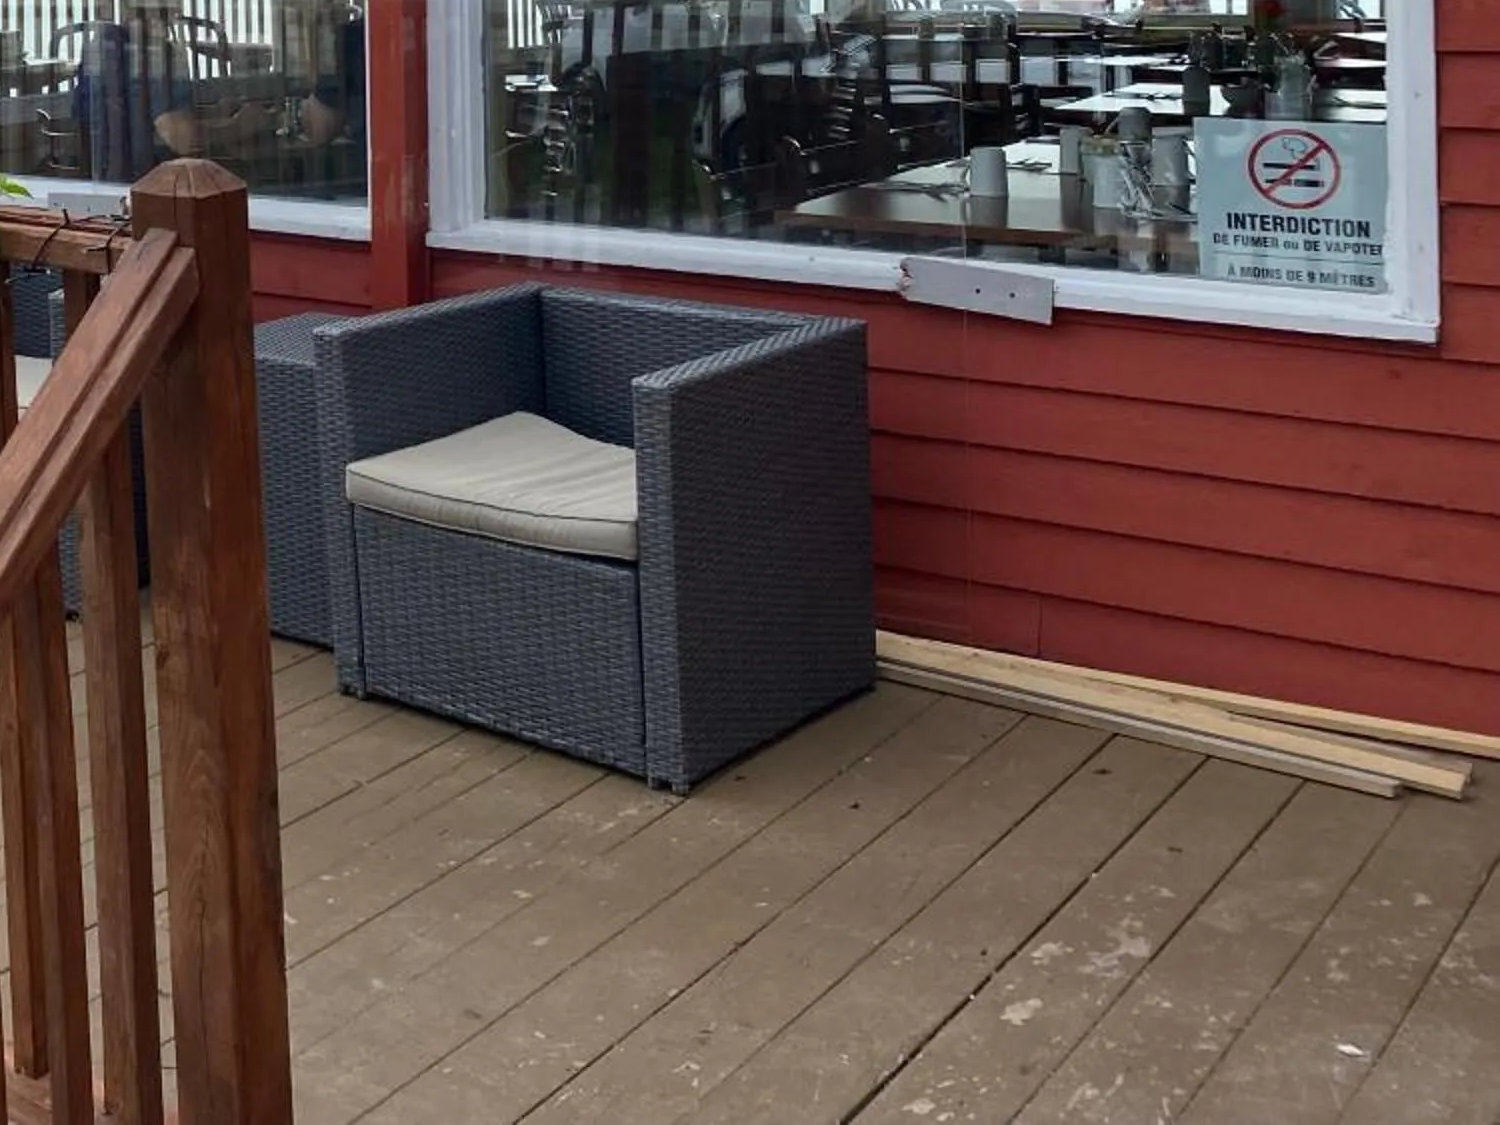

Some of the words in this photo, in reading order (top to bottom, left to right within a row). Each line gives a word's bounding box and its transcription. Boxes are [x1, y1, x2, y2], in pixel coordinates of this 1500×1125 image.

[1226, 212, 1371, 238] INTERDICTION
[1213, 232, 1229, 245] DE
[1233, 233, 1279, 249] FUMER
[1303, 239, 1321, 251] DE
[1240, 266, 1282, 280] MOINS
[1286, 269, 1303, 282] DE
[1307, 270, 1316, 284] 9
